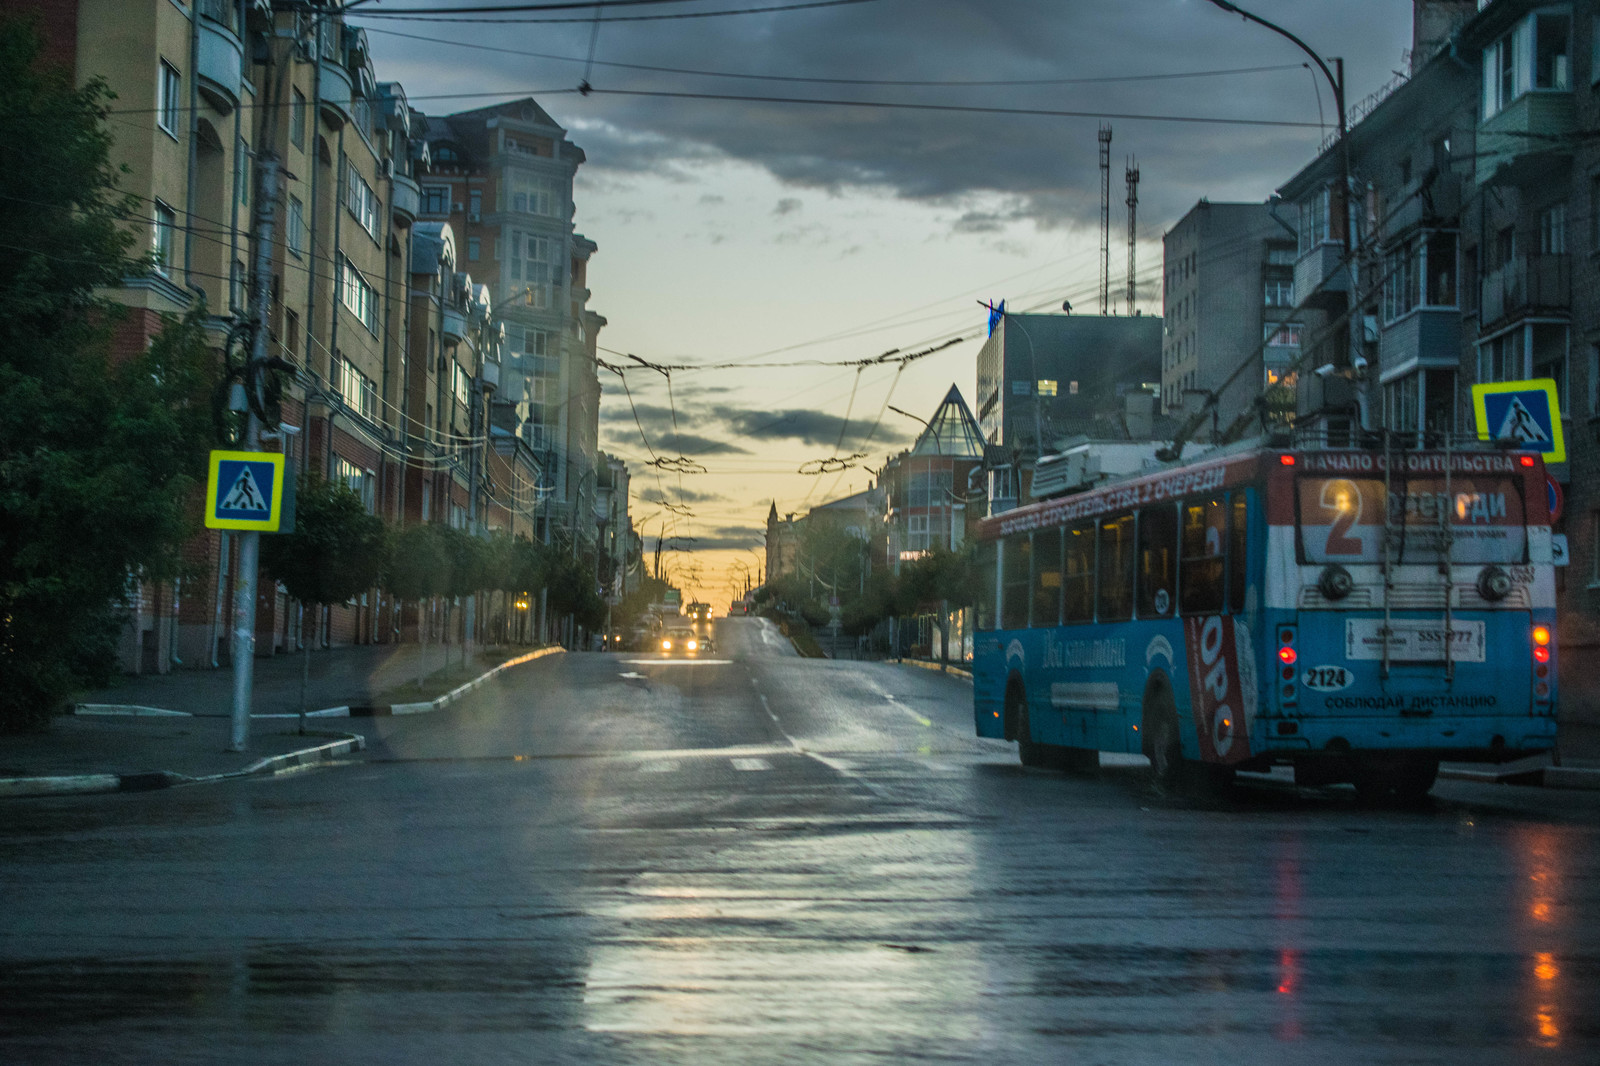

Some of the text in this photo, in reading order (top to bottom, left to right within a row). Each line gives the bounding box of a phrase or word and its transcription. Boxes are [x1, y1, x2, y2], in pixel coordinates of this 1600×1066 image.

[1304, 454, 1372, 471] НАЧАЛО
[1154, 466, 1226, 500] ОЧЕРЕДИ
[1320, 478, 1363, 555] 2
[1306, 669, 1346, 687] 2124
[1325, 695, 1497, 710] СОБЛЮДАЙ ДИСТАНЦИЮ
